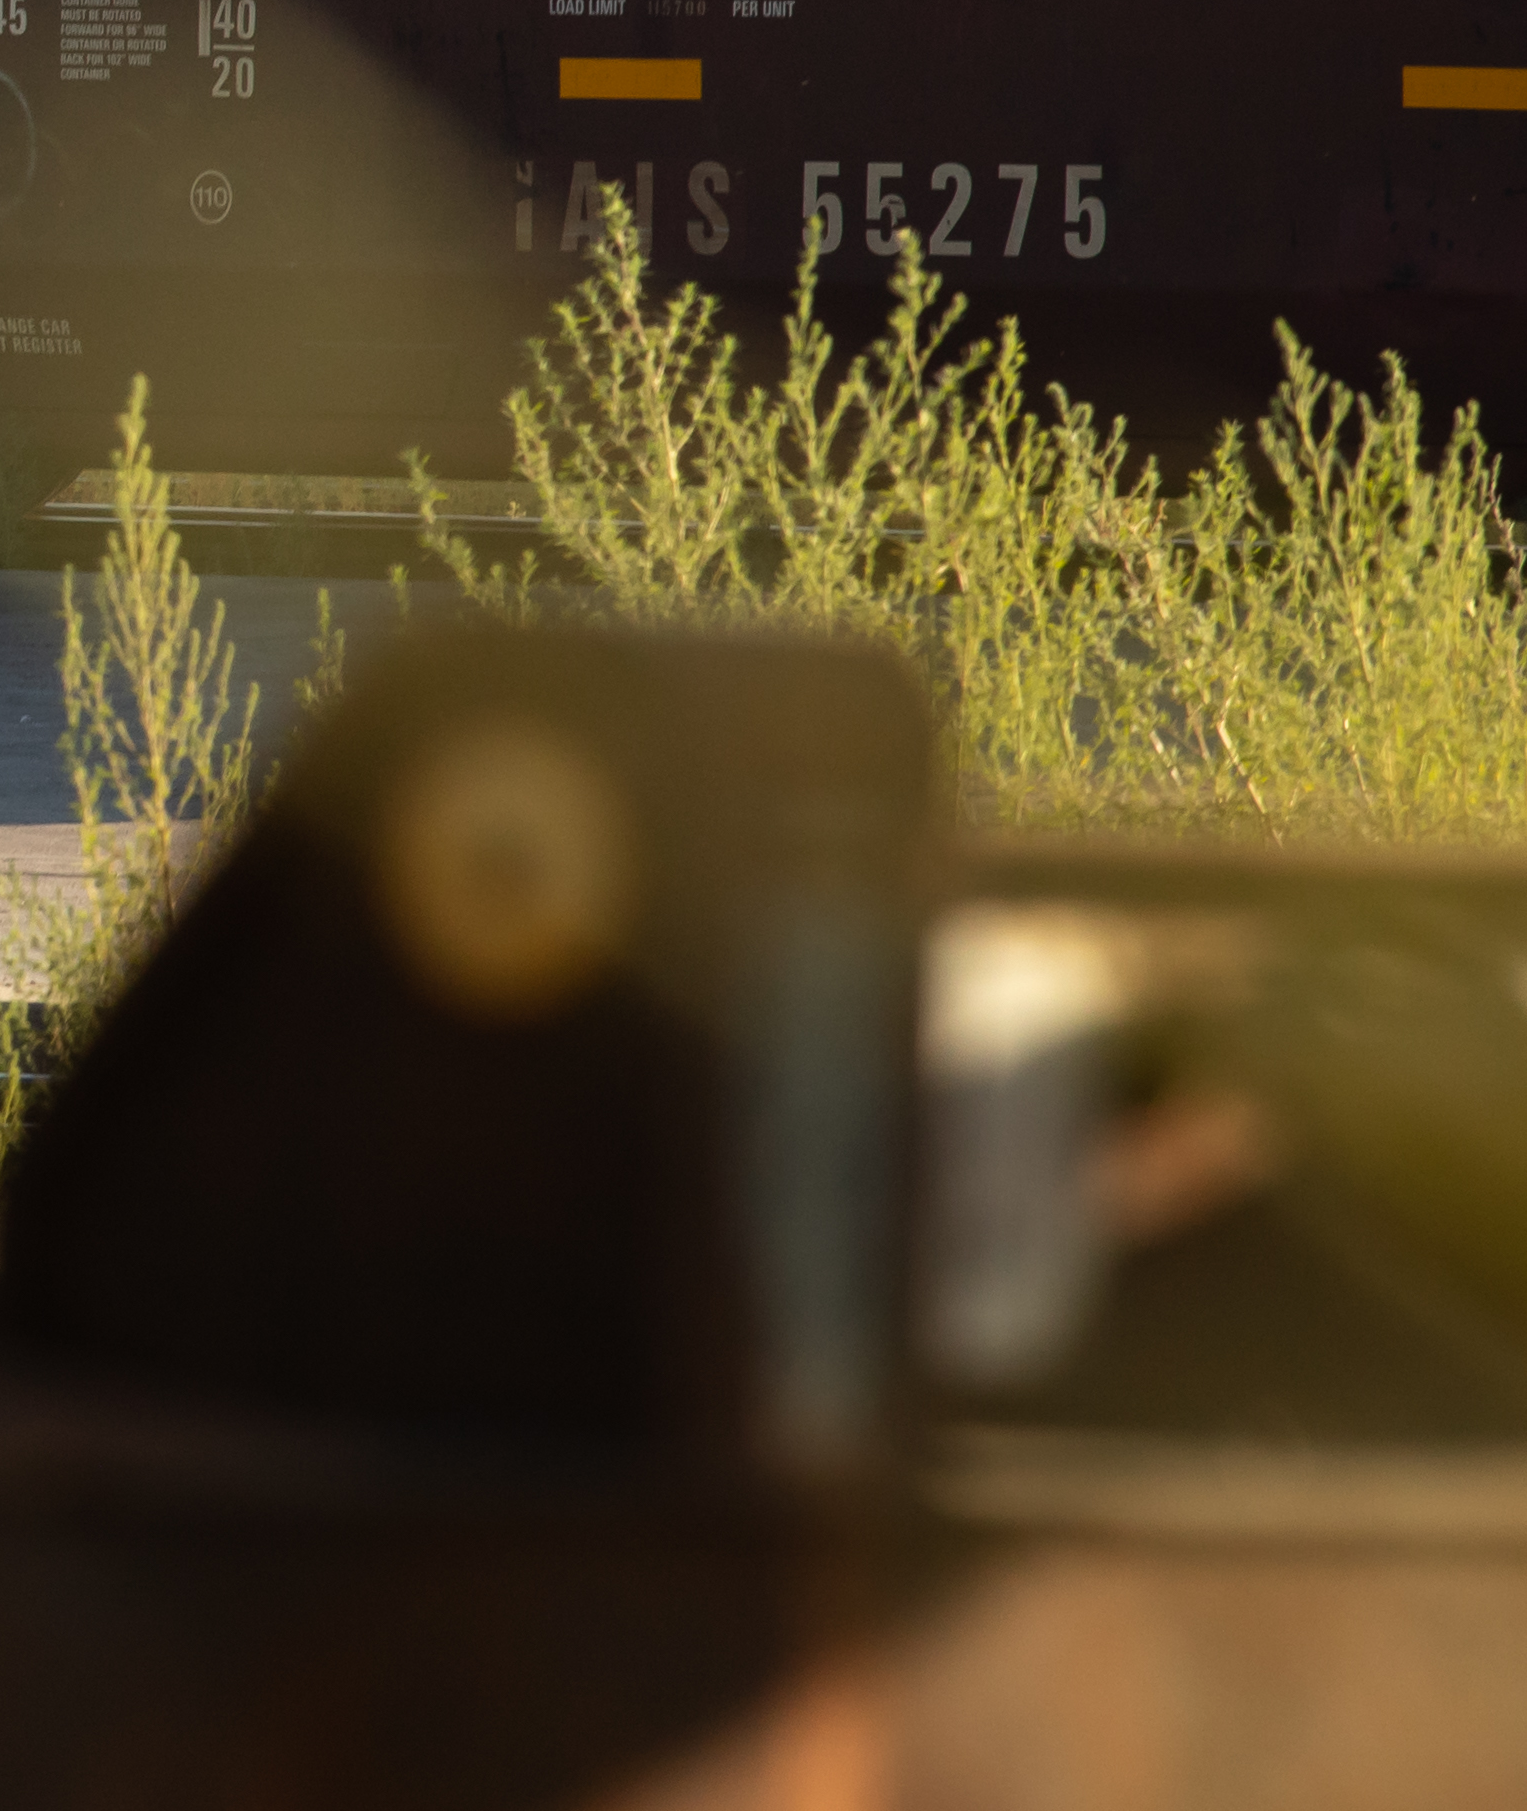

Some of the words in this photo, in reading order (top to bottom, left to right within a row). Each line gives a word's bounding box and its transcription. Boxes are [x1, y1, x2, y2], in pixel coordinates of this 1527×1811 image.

[60, 9, 86, 21] MUST
[88, 10, 100, 22] BE
[101, 10, 141, 22] ROTATED
[732, 0, 759, 18] PER
[763, 0, 795, 18] UNIT
[60, 23, 104, 36] FORWARD
[106, 24, 124, 37] FOR
[143, 24, 168, 37] WIDE
[60, 38, 110, 51] CONTAINER
[111, 39, 125, 51] OR
[126, 39, 167, 52] ROTATED
[60, 53, 84, 66] BACK
[86, 53, 104, 66] FOR
[128, 54, 152, 67] WIDE
[60, 67, 111, 81] CONTAINER
[211, 54, 256, 100] 20
[800, 160, 1109, 259] 55275
[40, 317, 71, 336] CAR
[12, 335, 84, 356] REGISTER
